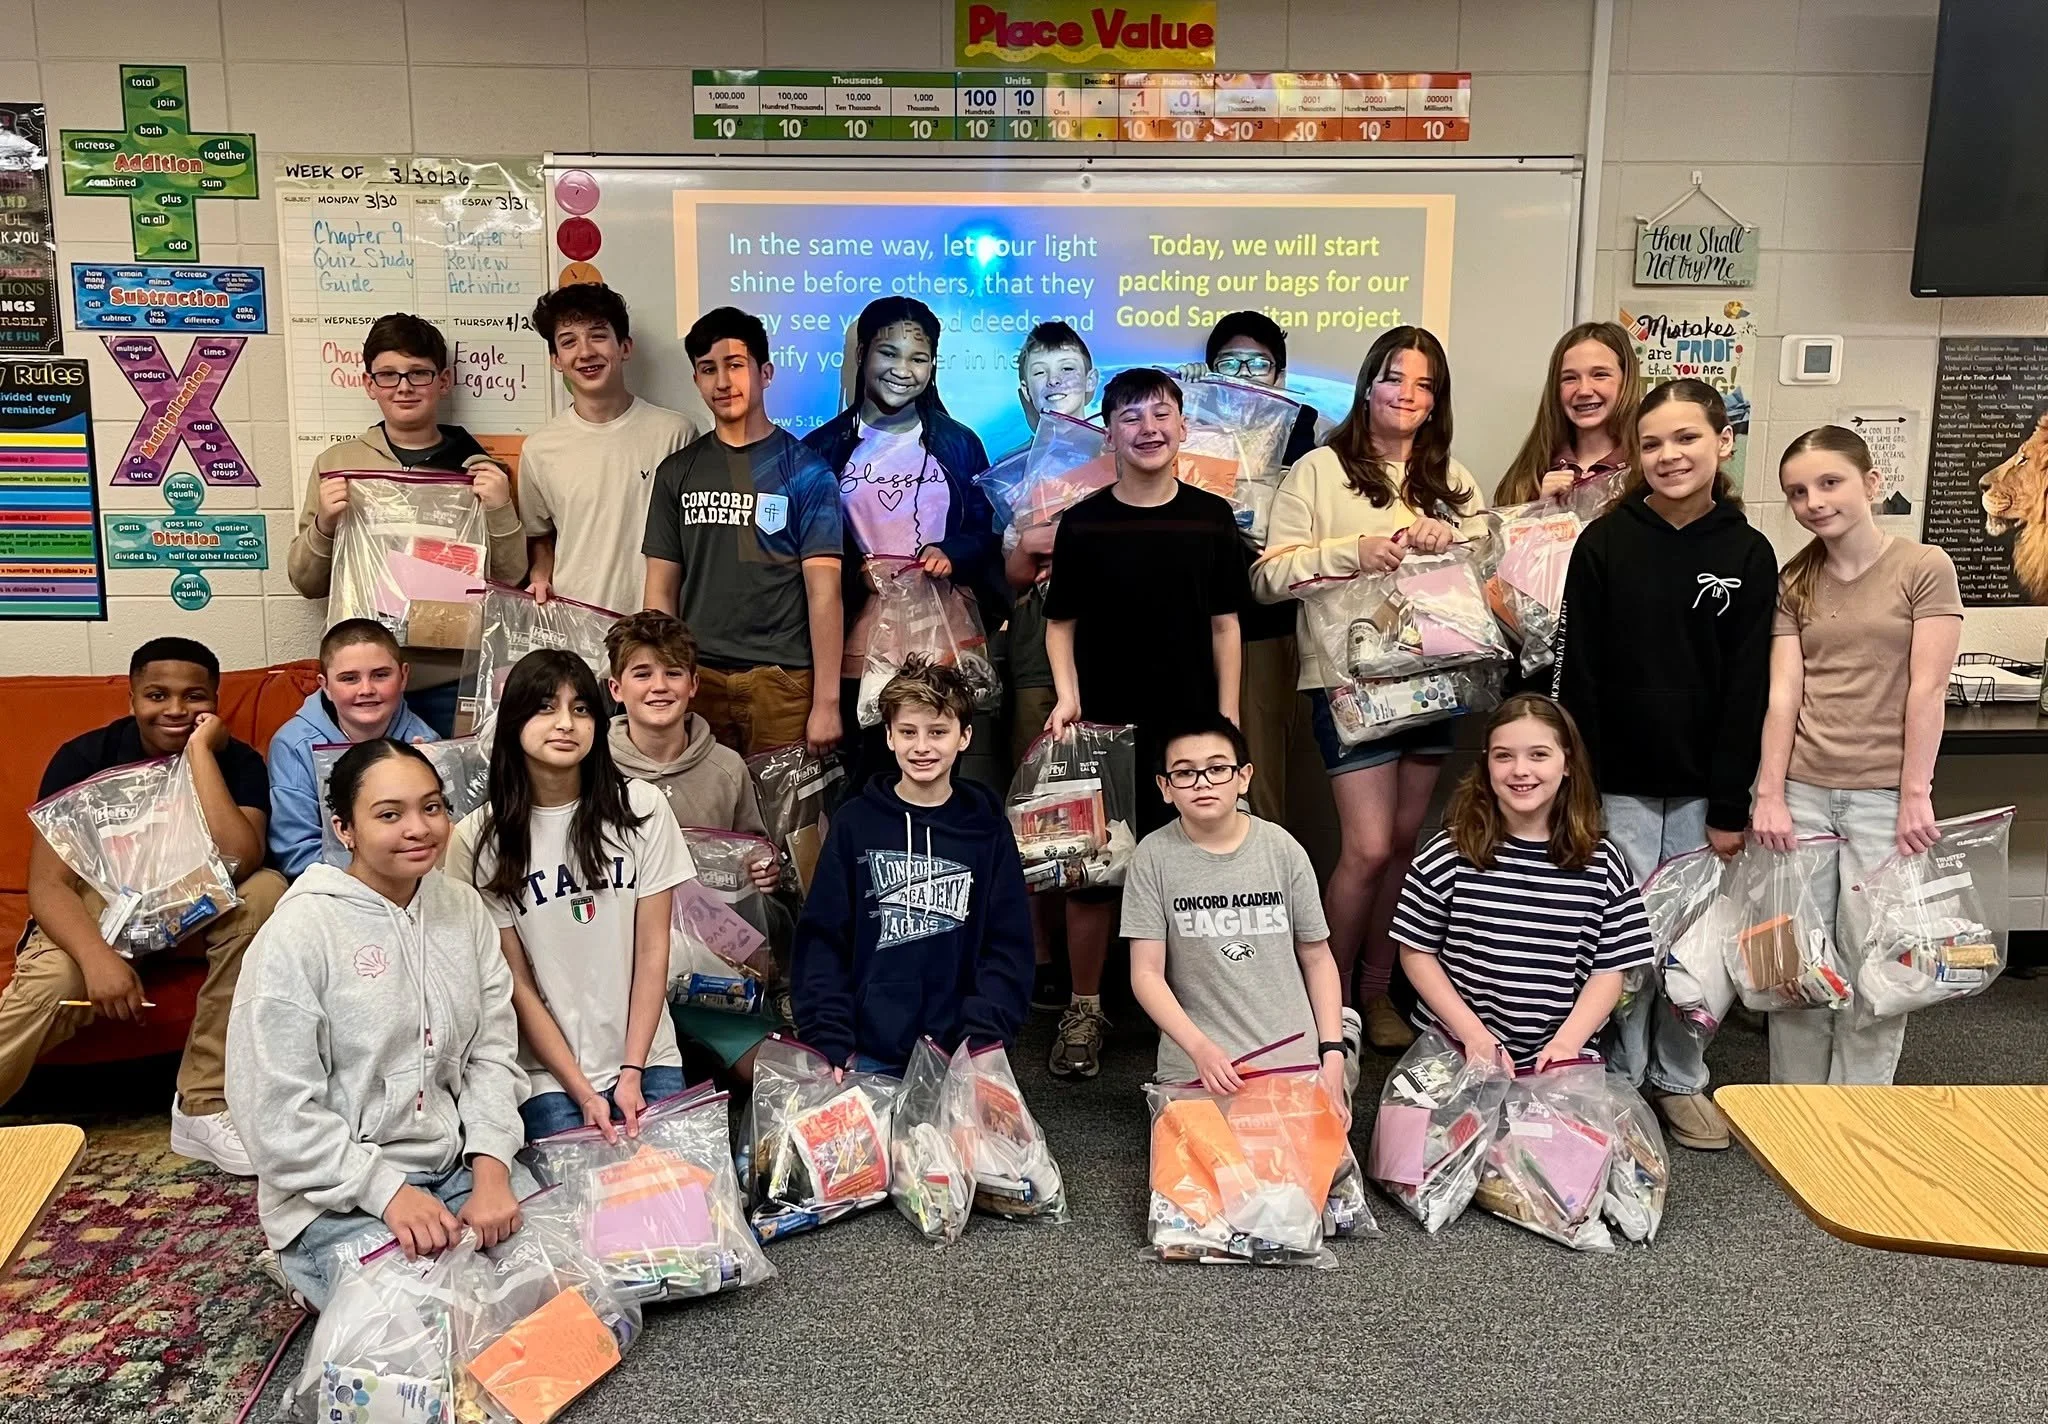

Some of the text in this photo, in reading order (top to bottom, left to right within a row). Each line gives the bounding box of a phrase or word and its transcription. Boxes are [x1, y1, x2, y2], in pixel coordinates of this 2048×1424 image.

[968, 4, 1214, 48] Place Value
[132, 78, 154, 86] total
[832, 76, 883, 85] Thousands
[1005, 76, 1032, 85] Units
[1084, 78, 1116, 86] Decimal
[157, 98, 176, 108] join
[708, 92, 746, 100] 1,000,000
[778, 92, 808, 100] 100,000
[846, 92, 871, 101] 10,000
[913, 94, 934, 102] 1,000
[964, 90, 996, 106] 100
[1014, 90, 1034, 106] 10
[1132, 91, 1144, 106] .1
[140, 126, 162, 135] both
[75, 141, 115, 150] increase
[218, 141, 230, 150] all
[204, 150, 245, 161] together
[114, 153, 204, 174] Addition
[286, 164, 470, 185] WEEK OF 3/30/26
[86, 178, 136, 187] combined
[201, 180, 222, 188] sum
[162, 195, 182, 205] plus
[318, 192, 397, 209] MONDAY 3/30
[496, 192, 528, 210] 3/31
[141, 214, 165, 224] in all
[16, 232, 40, 244] YOU
[314, 220, 403, 250] Chapter 9
[445, 222, 504, 252] Chapter
[1642, 225, 1744, 254] thou Shall
[168, 241, 187, 250] add
[729, 232, 1097, 262] In the same way, let our light
[1150, 234, 1380, 260] Today, we will start
[314, 248, 415, 279] Quiz Study
[446, 249, 508, 270] Review
[1643, 252, 1735, 282] Not try Me
[84, 277, 106, 285] many
[319, 271, 374, 293] Guide
[448, 272, 520, 294] Activities
[730, 271, 1094, 299] shine before others, that they
[1119, 270, 1409, 297] packing our bags for our
[110, 287, 229, 308] Subtraction
[324, 317, 378, 325] WEDNESDA
[454, 313, 534, 332] THURSDAY 4/2
[790, 314, 831, 330] see
[970, 309, 1040, 332] deeds
[1116, 305, 1180, 327] Good
[1316, 306, 1408, 332] project.
[17, 332, 40, 341] FUN
[1637, 314, 1736, 347] Mistakes
[204, 348, 226, 356] times
[454, 341, 508, 365] Eagle
[1648, 339, 1735, 363] are PROOF
[14, 363, 84, 386] Rules
[134, 372, 166, 380] product
[1648, 363, 1672, 375] that
[1673, 364, 1698, 375] YOU
[453, 364, 527, 401] Legacy!
[37, 394, 72, 404] evenly
[2, 406, 56, 414] remainder
[140, 361, 212, 459] Multiplication
[795, 416, 824, 427] 5:16
[206, 443, 216, 451] by
[840, 461, 947, 494] Blessed
[681, 491, 754, 510] CONCORD
[684, 509, 752, 526] ACADEMY
[152, 532, 220, 546] Division
[114, 552, 157, 561] divided by
[169, 552, 258, 561] half (or other fraction)
[176, 590, 206, 598] equally
[1173, 894, 1229, 912] CONCORD
[1174, 905, 1290, 937] EAGLES
